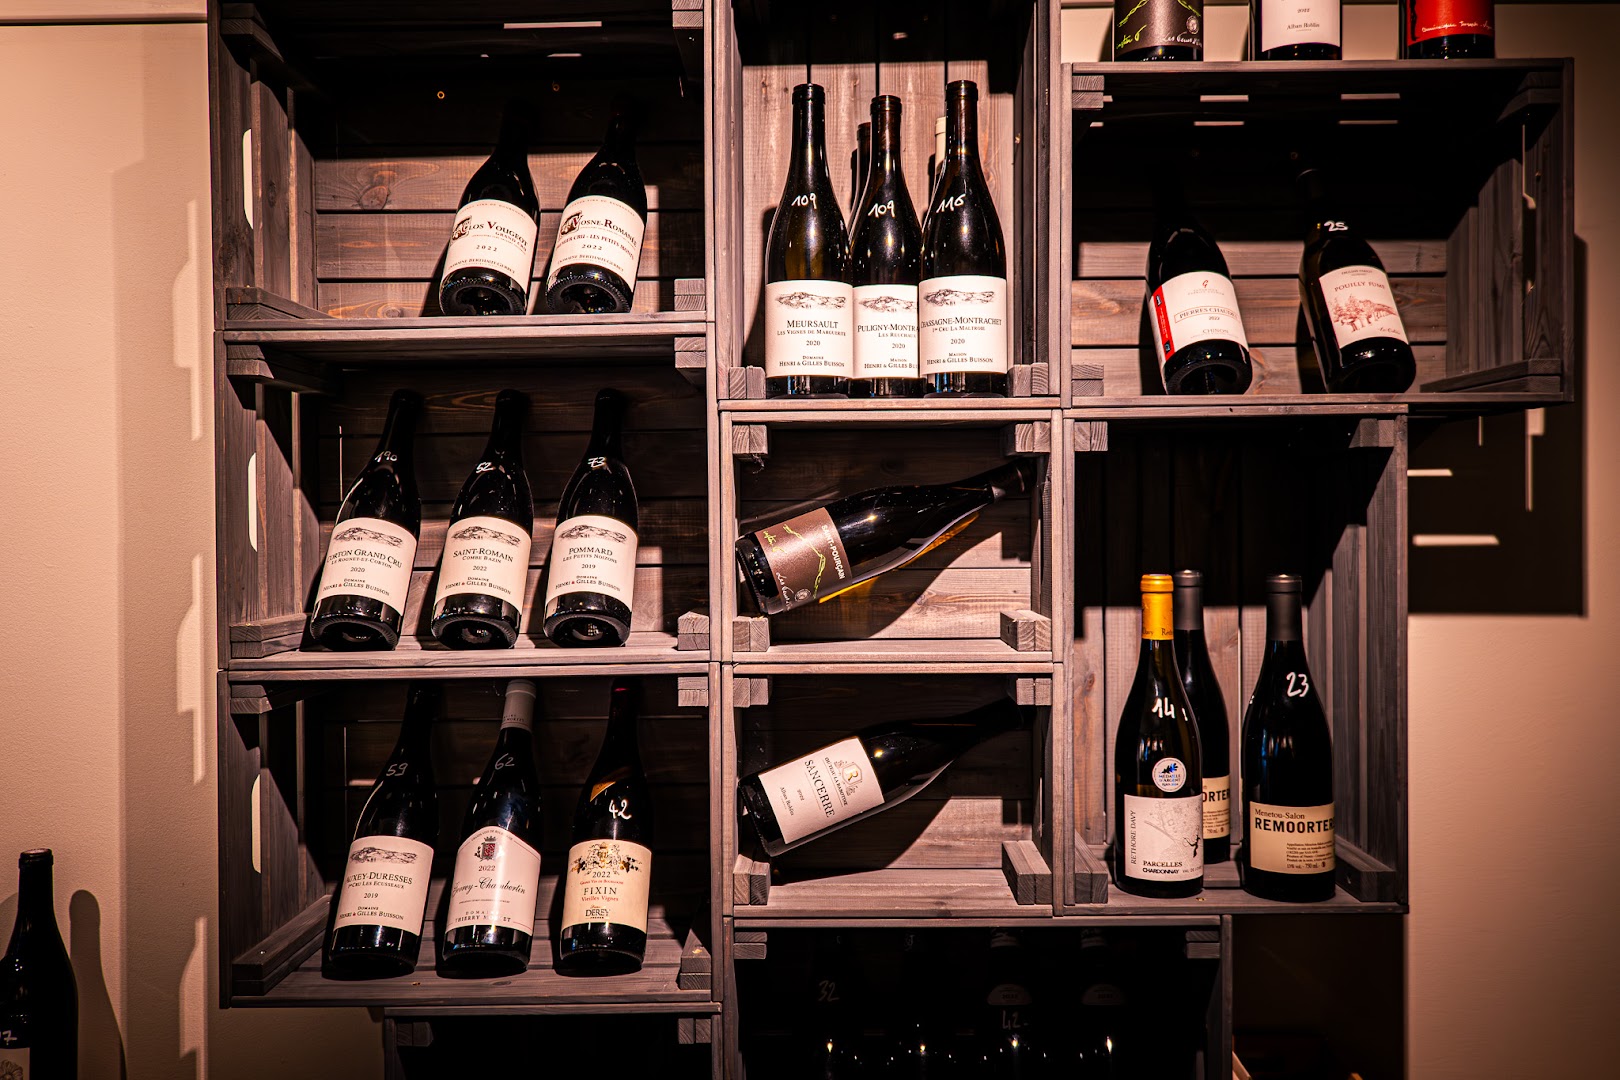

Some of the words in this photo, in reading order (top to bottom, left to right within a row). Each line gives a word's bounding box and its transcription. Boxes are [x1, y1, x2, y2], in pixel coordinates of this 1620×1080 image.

[791, 192, 817, 209] 109
[936, 193, 966, 213] 116
[868, 200, 896, 218] 109
[476, 244, 498, 252] 2022
[1334, 282, 1365, 292] POUILLY
[1179, 308, 1208, 318] PIERRES
[786, 320, 838, 329] MEURSAULT
[476, 461, 494, 473] 52
[453, 548, 514, 563] SAINT-ROMAIN
[568, 547, 613, 556] POMMARD
[354, 548, 386, 560] GRAND
[387, 556, 402, 569] CRU
[366, 584, 389, 596] BUISSON
[489, 583, 511, 595] BUISSON
[1286, 672, 1309, 698] 23
[494, 752, 515, 770] 62
[386, 762, 408, 776] 59
[804, 759, 836, 818] SANCERRE
[608, 798, 632, 820] 42
[1254, 808, 1305, 819] Menetou-Salon
[584, 886, 617, 895] FIXIN
[379, 911, 404, 920] BUISSON
[586, 909, 609, 917] DEREY
